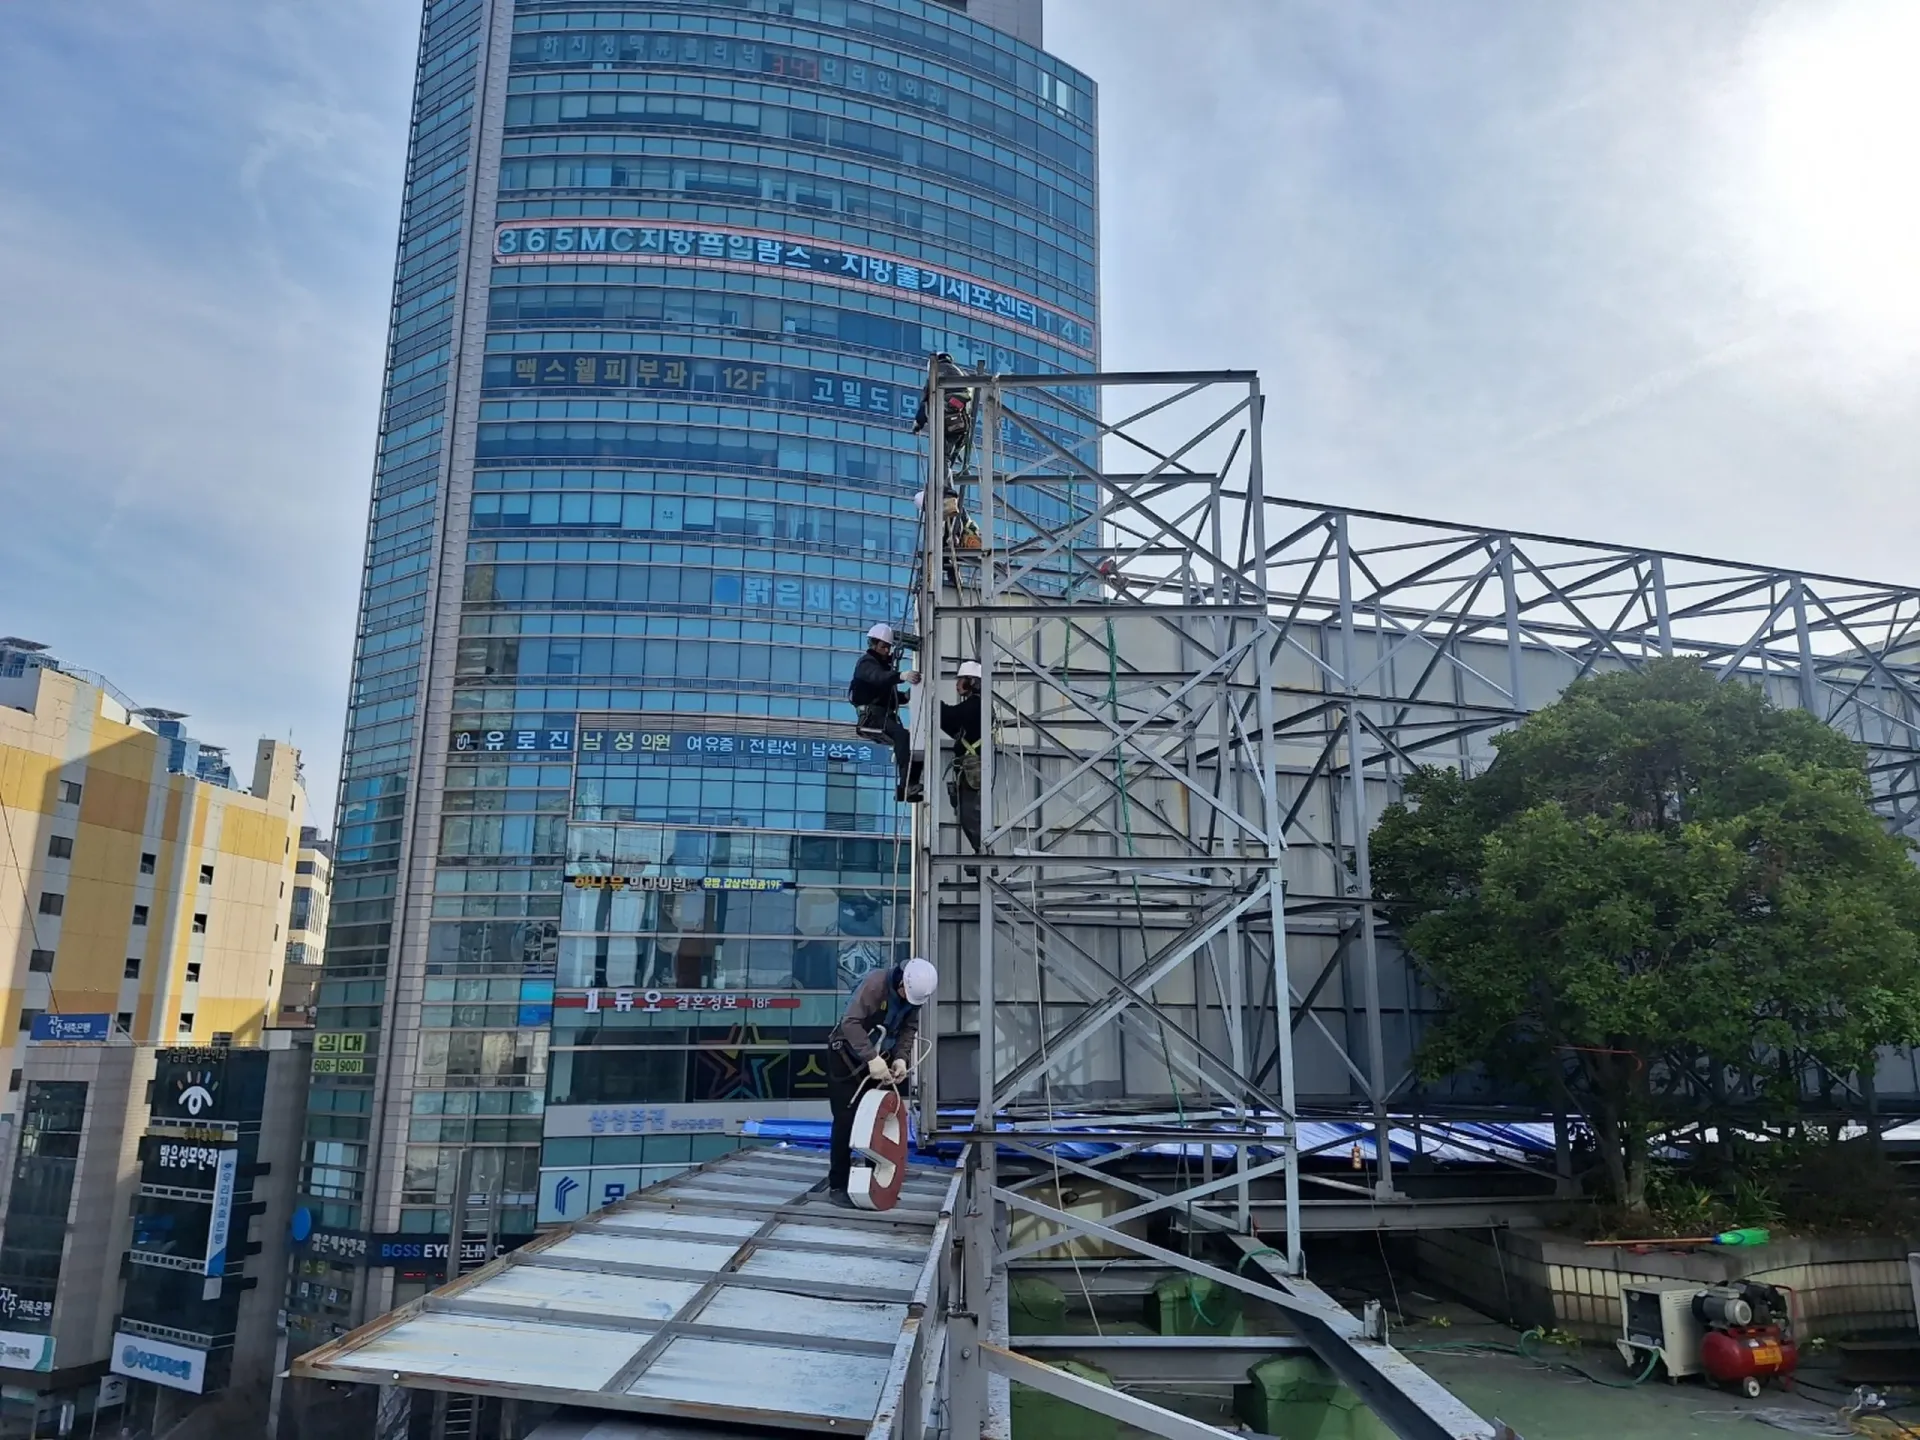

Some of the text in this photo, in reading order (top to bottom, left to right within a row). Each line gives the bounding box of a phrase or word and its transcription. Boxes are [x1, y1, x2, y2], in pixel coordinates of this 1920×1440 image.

[516, 356, 687, 388] 맥스웰피부과
[722, 367, 766, 393] 12F
[749, 738, 797, 756] 전립선
[614, 990, 662, 1012] 듀오
[675, 994, 738, 1012] 결혼정보
[751, 997, 771, 1009] 18F
[319, 1034, 361, 1052] 임대
[314, 1059, 361, 1072] 608-9001
[382, 1243, 420, 1257] BGSS
